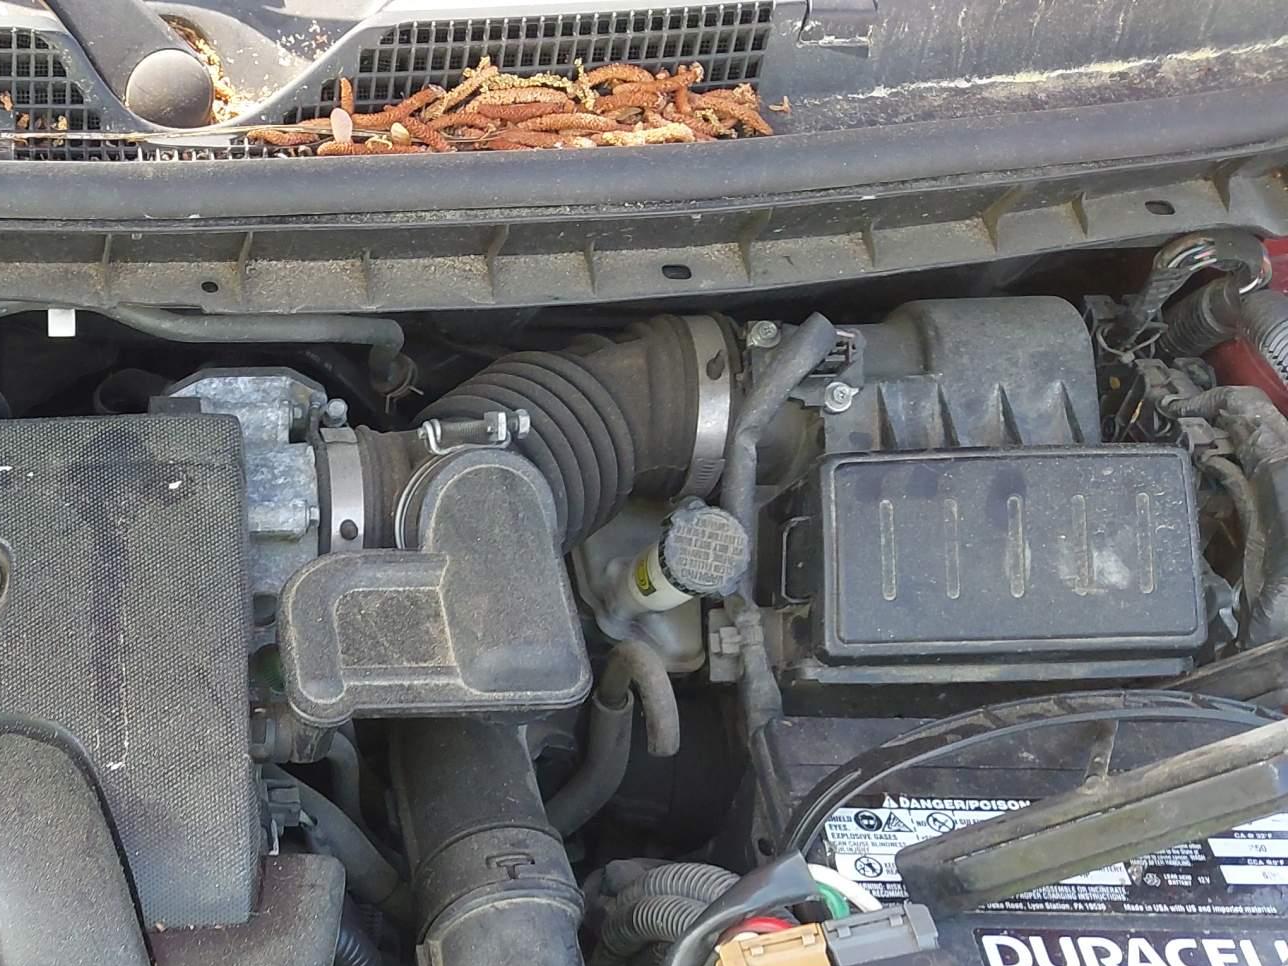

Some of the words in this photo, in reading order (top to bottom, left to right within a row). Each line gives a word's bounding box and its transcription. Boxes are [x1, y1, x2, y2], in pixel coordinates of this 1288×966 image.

[1027, 902, 1045, 911] Lyon
[1045, 902, 1073, 911] Station,
[1074, 903, 1084, 911] PA
[1123, 904, 1144, 912] Made
[1145, 904, 1153, 912] in
[1153, 904, 1169, 912] USA
[1170, 904, 1185, 912] with
[1186, 904, 1197, 912] US
[1212, 905, 1243, 914] imported
[1244, 905, 1278, 914] materials
